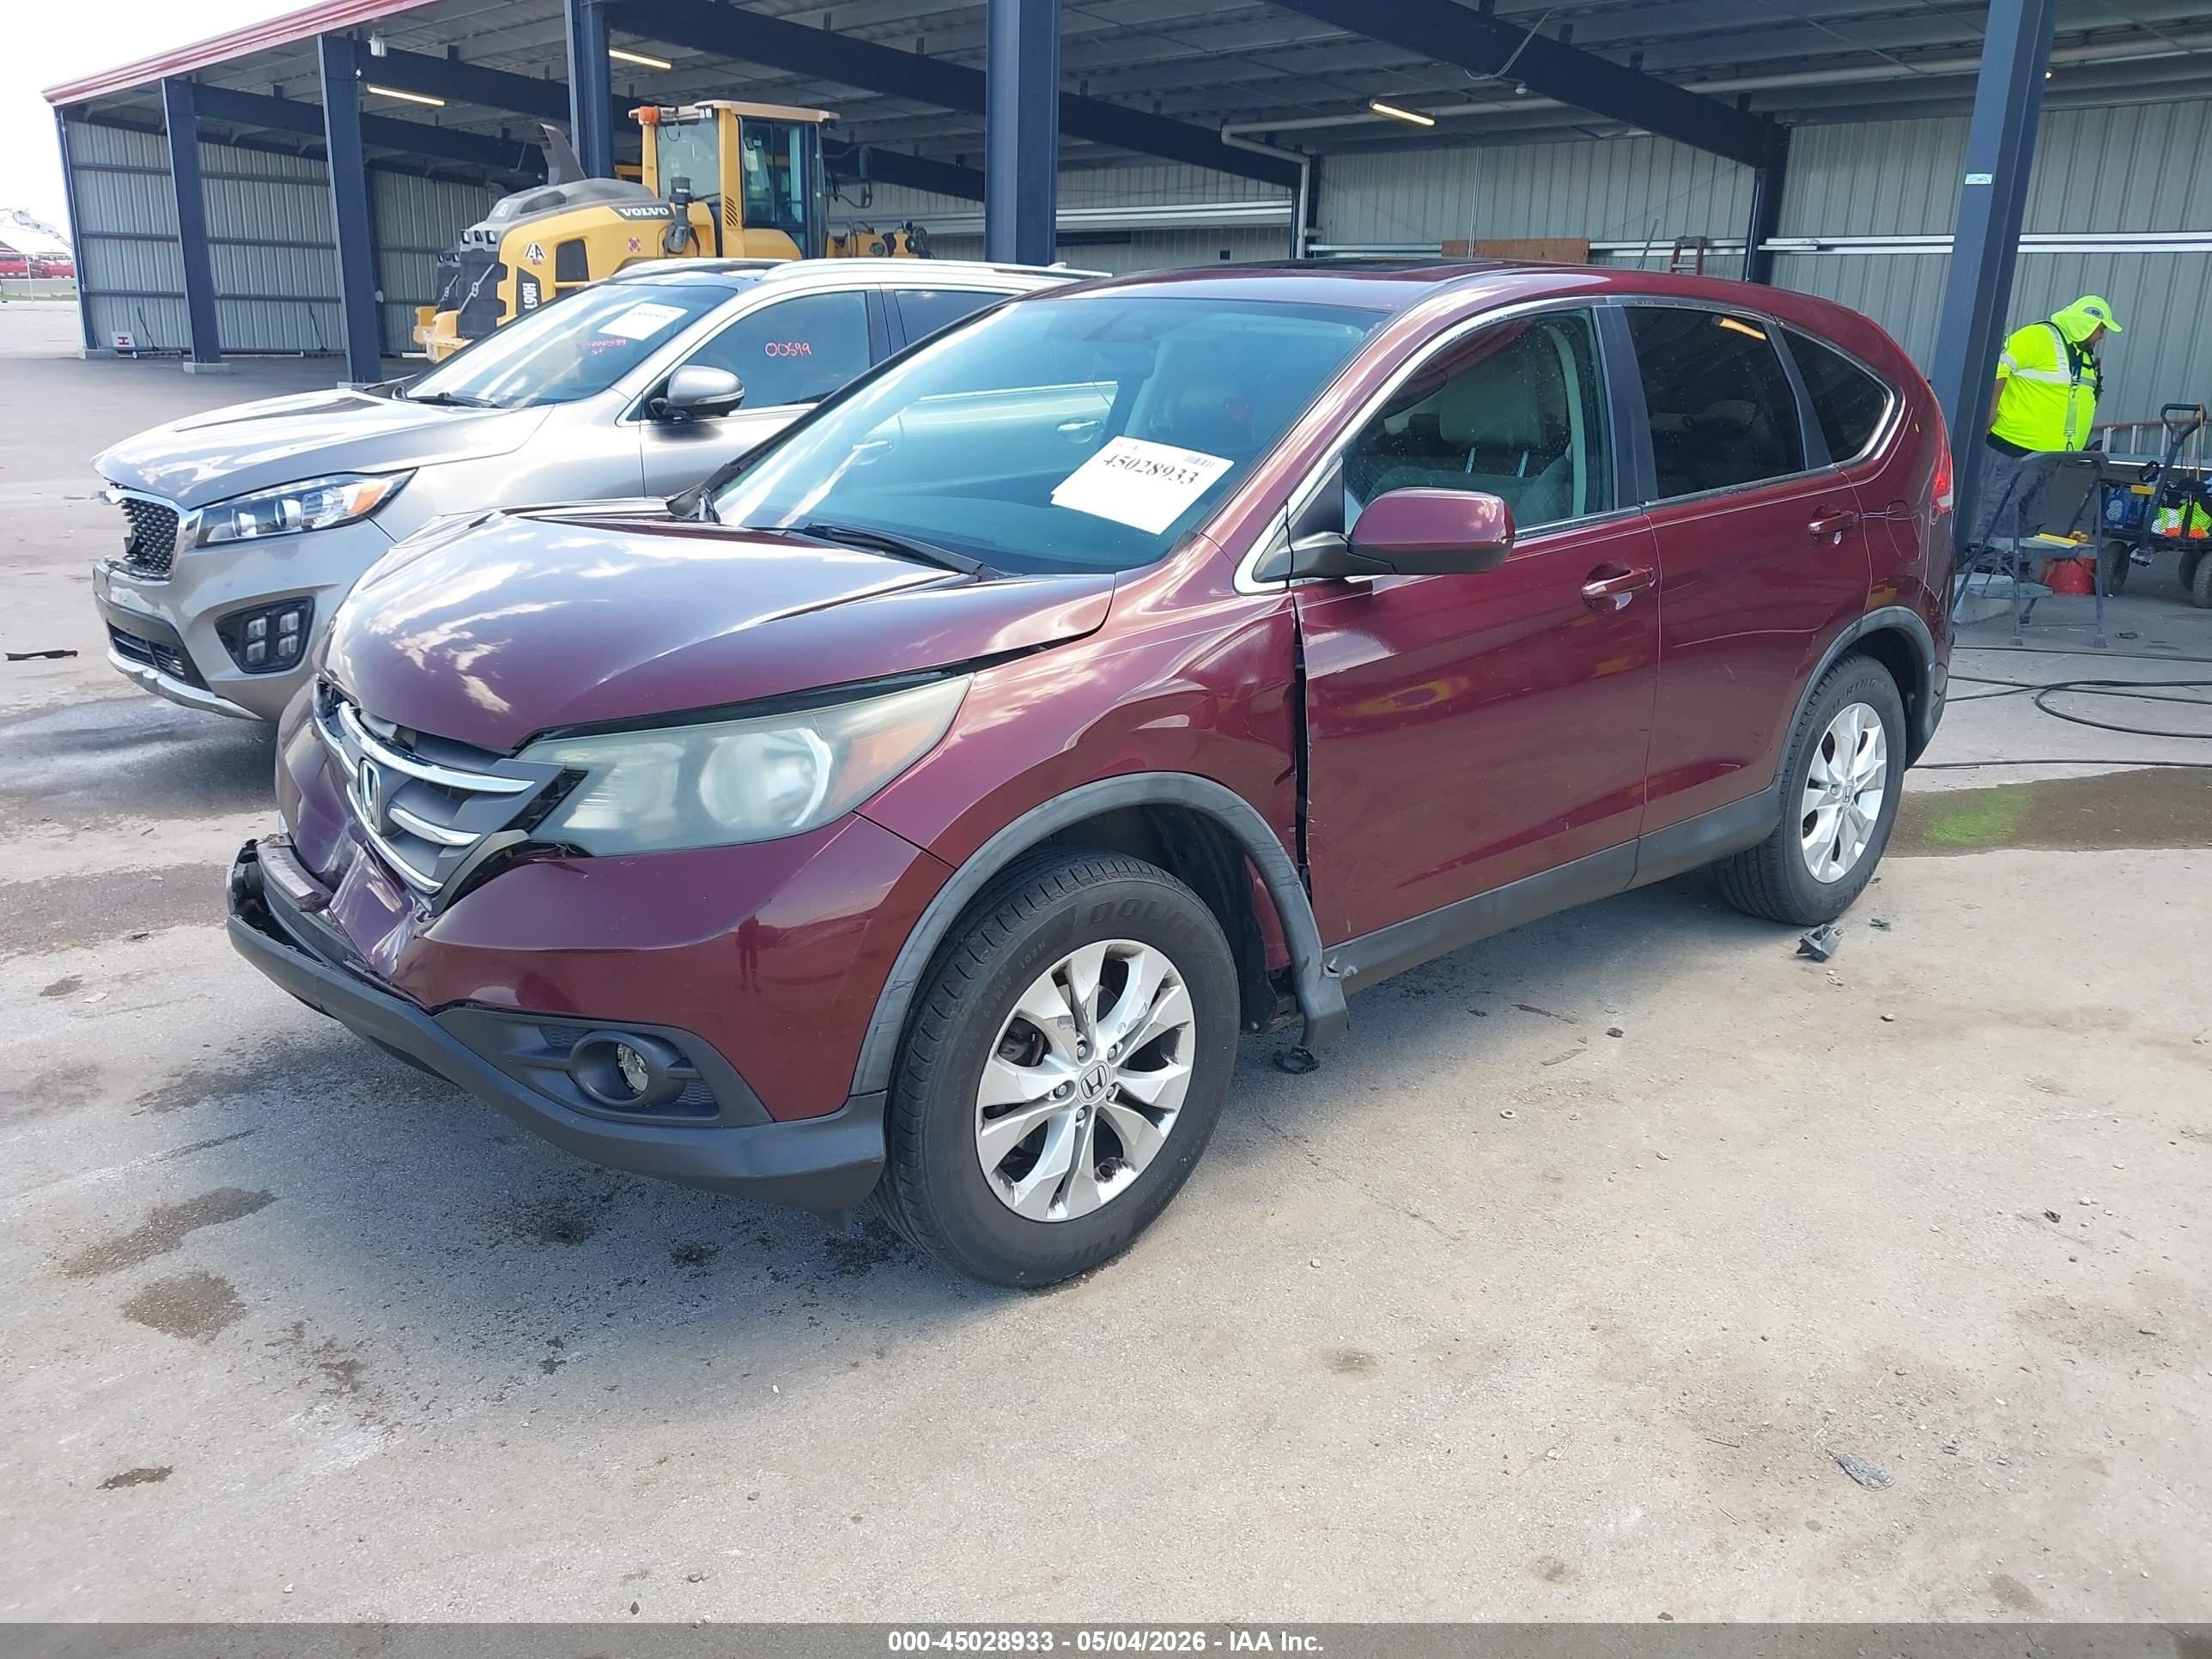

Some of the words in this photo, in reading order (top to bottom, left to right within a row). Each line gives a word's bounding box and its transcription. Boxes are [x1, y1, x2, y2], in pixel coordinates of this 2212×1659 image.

[618, 207, 670, 216] VOLVO
[764, 342, 811, 357] 00599
[1103, 453, 1200, 484] 45028933
[1018, 940, 1047, 969] 102H
